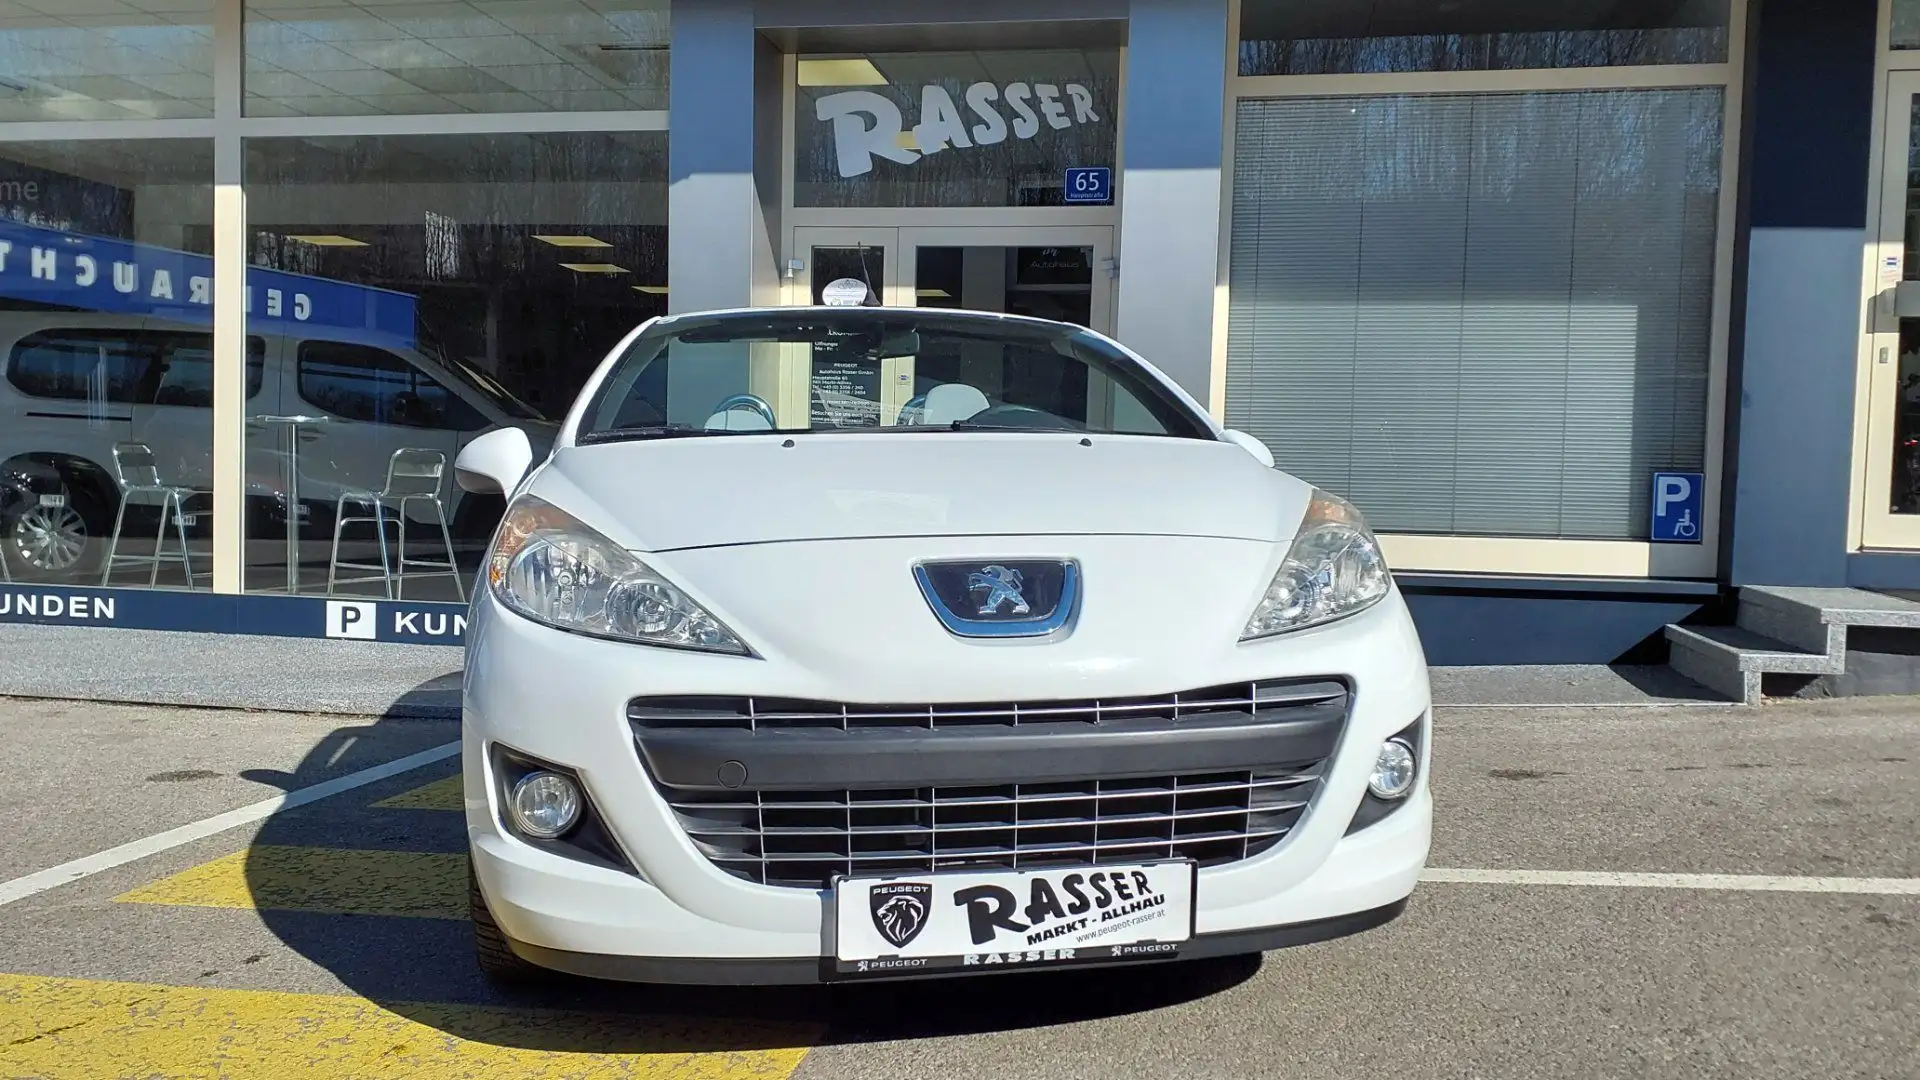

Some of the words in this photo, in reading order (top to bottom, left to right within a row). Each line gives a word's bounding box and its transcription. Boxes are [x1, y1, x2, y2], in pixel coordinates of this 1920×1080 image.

[815, 81, 1100, 178] RASSER
[1075, 172, 1100, 191] 65
[1656, 476, 1691, 516] P
[341, 606, 361, 634] P
[873, 885, 929, 895] PEUGEOT
[953, 870, 1153, 946] RASSER
[1027, 917, 1089, 946] MARKT
[1101, 893, 1166, 923] ALLHAU
[1075, 908, 1166, 944] www.peugeot-rasser.at
[963, 947, 1077, 966] RASSER
[1124, 943, 1178, 954] PEUGEOT
[871, 958, 928, 969] PEUGEOT
